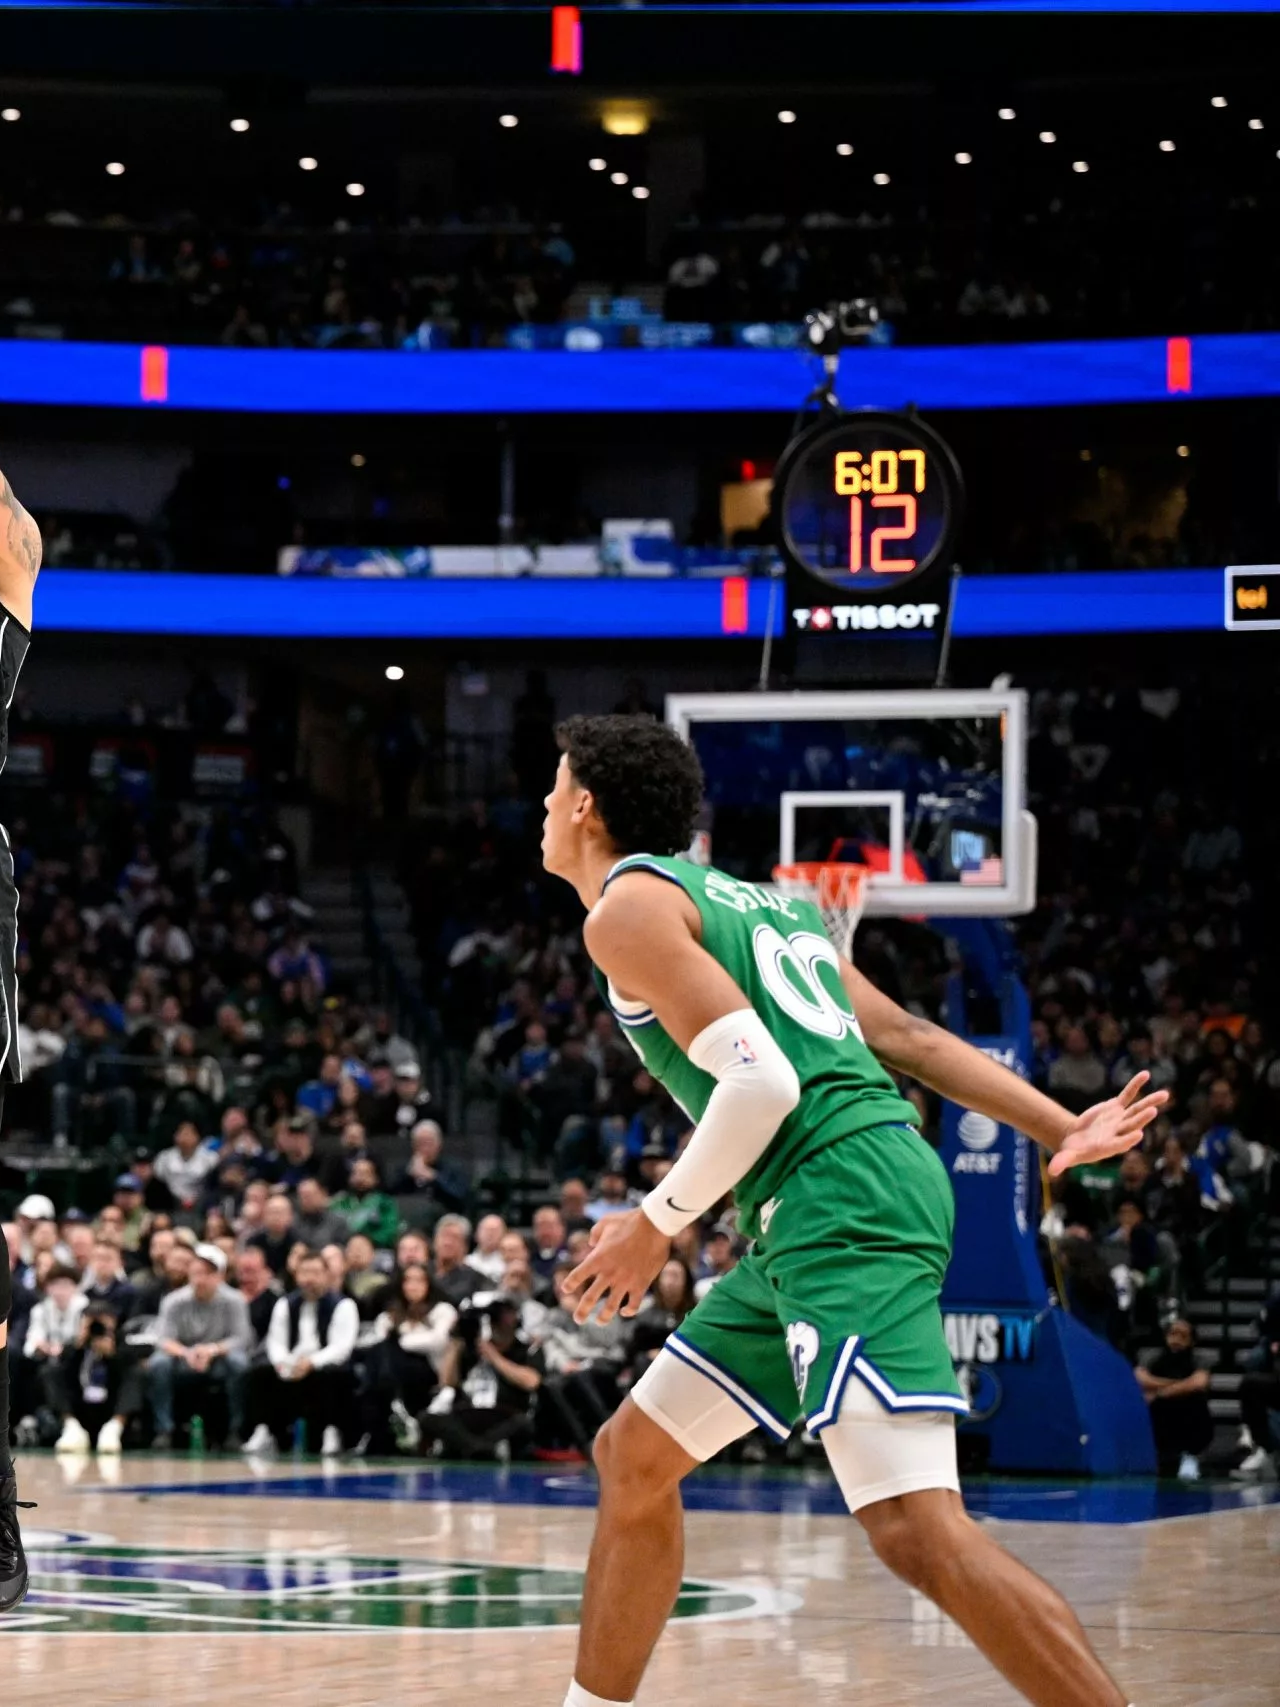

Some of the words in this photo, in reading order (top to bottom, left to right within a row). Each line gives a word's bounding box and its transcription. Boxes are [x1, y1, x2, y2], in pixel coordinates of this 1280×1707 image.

[835, 449, 926, 495] 6:07
[850, 494, 917, 574] 12
[831, 603, 940, 631] TISSOT
[752, 923, 865, 1044] 00
[952, 1151, 1003, 1174] AT&T
[943, 1313, 1000, 1363] AVS
